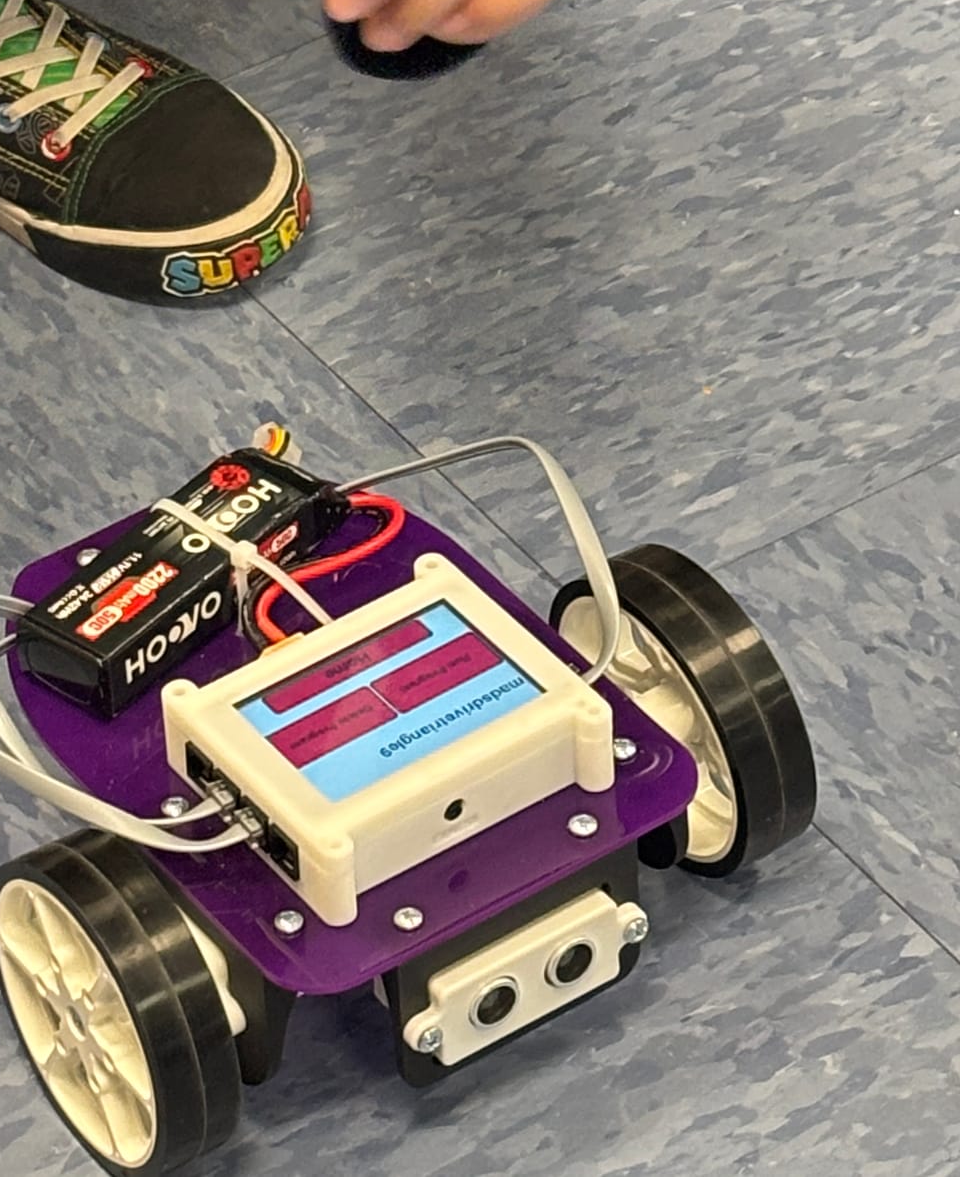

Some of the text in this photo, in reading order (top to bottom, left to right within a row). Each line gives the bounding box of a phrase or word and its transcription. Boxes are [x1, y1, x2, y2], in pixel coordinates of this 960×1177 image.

[87, 609, 118, 632] 50C
[324, 651, 372, 679] Home
[379, 676, 525, 758] madsdrivetriangle9
